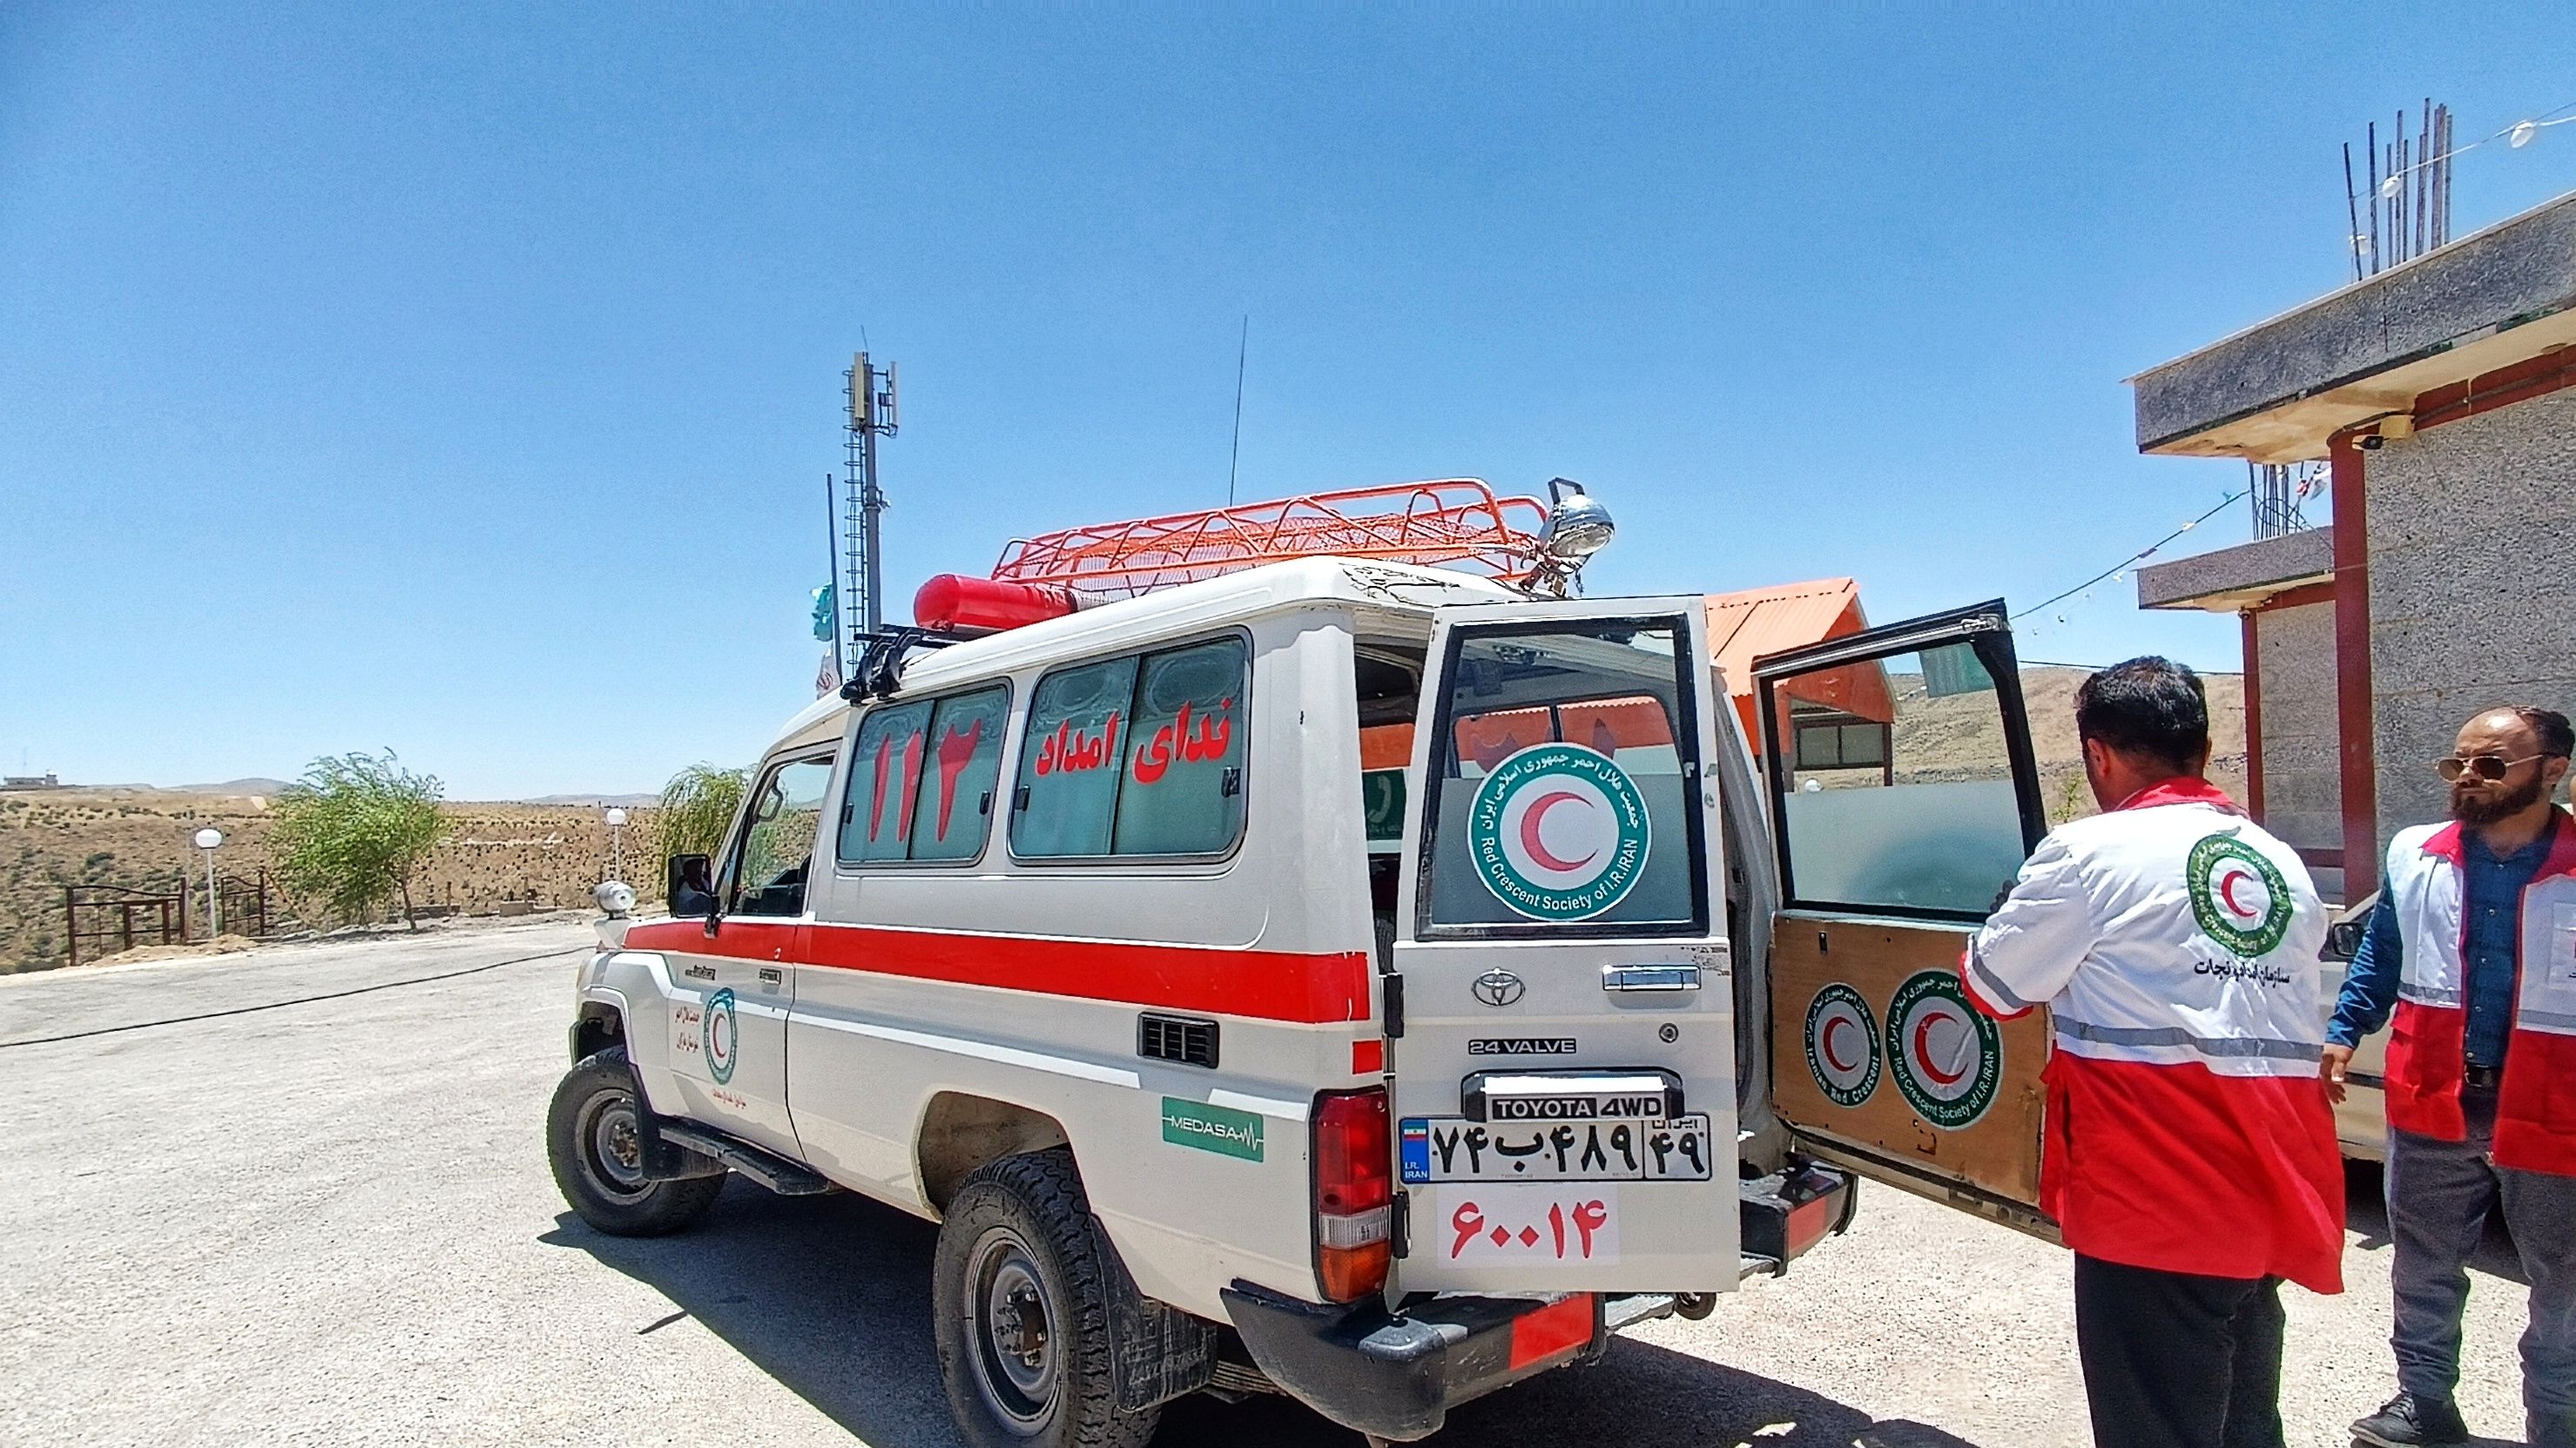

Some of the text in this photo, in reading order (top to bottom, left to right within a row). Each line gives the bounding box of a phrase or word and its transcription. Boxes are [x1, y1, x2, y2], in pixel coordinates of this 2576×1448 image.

[1035, 697, 1234, 783] ندای امداد
[869, 717, 982, 843] ۱۱۲
[1480, 752, 1640, 831] جمعیت هلال احمر جمهوری اسلامی ایران
[1481, 837, 1496, 864] Red
[1491, 863, 1541, 907] Crescent
[1541, 893, 1593, 911] Society
[1595, 883, 1608, 900] of
[2194, 958, 2231, 980] نجات
[1469, 1040, 1575, 1054] 24 VALVE
[1807, 1047, 1828, 1091] Iranian
[1831, 1088, 1848, 1104] Red
[1497, 1097, 1662, 1117] TOYOTA 4WD
[1894, 1056, 1908, 1080] Red
[1905, 1079, 1938, 1115] Crescent
[1939, 1103, 1971, 1120] Society
[1969, 1094, 1979, 1108] of
[1171, 1115, 1238, 1140] MEDASA
[1649, 1132, 1706, 1175] ۴۹
[1405, 1170, 1428, 1179] IRAN
[1452, 1199, 1608, 1260] ۶۰۰۱۴
